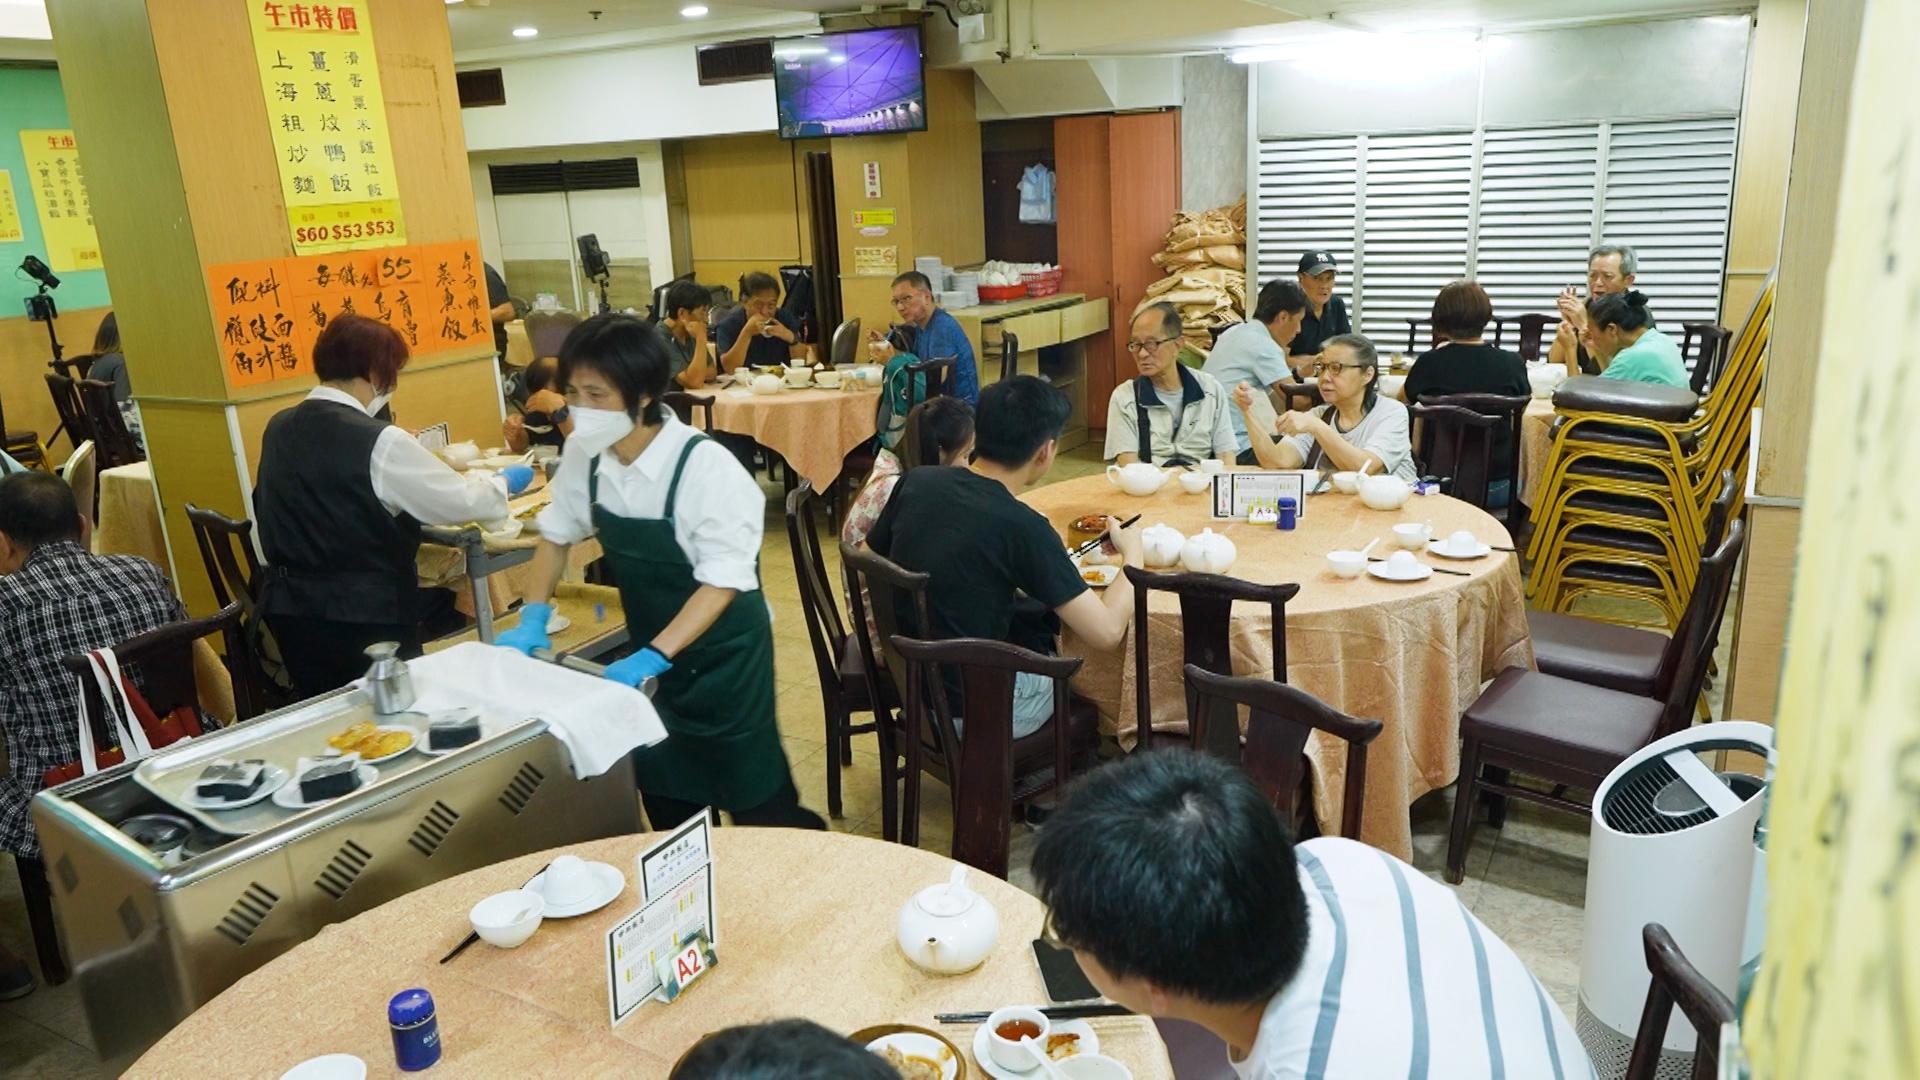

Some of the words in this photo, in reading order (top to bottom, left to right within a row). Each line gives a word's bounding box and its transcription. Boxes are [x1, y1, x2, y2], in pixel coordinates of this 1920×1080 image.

[264, 1, 358, 30] 午市特價
[272, 50, 316, 194] 上海粗炒麵
[296, 226, 328, 243] $60
[332, 223, 362, 240] $53
[366, 220, 395, 236] $53
[382, 256, 412, 280] 55
[677, 949, 702, 983] A2
